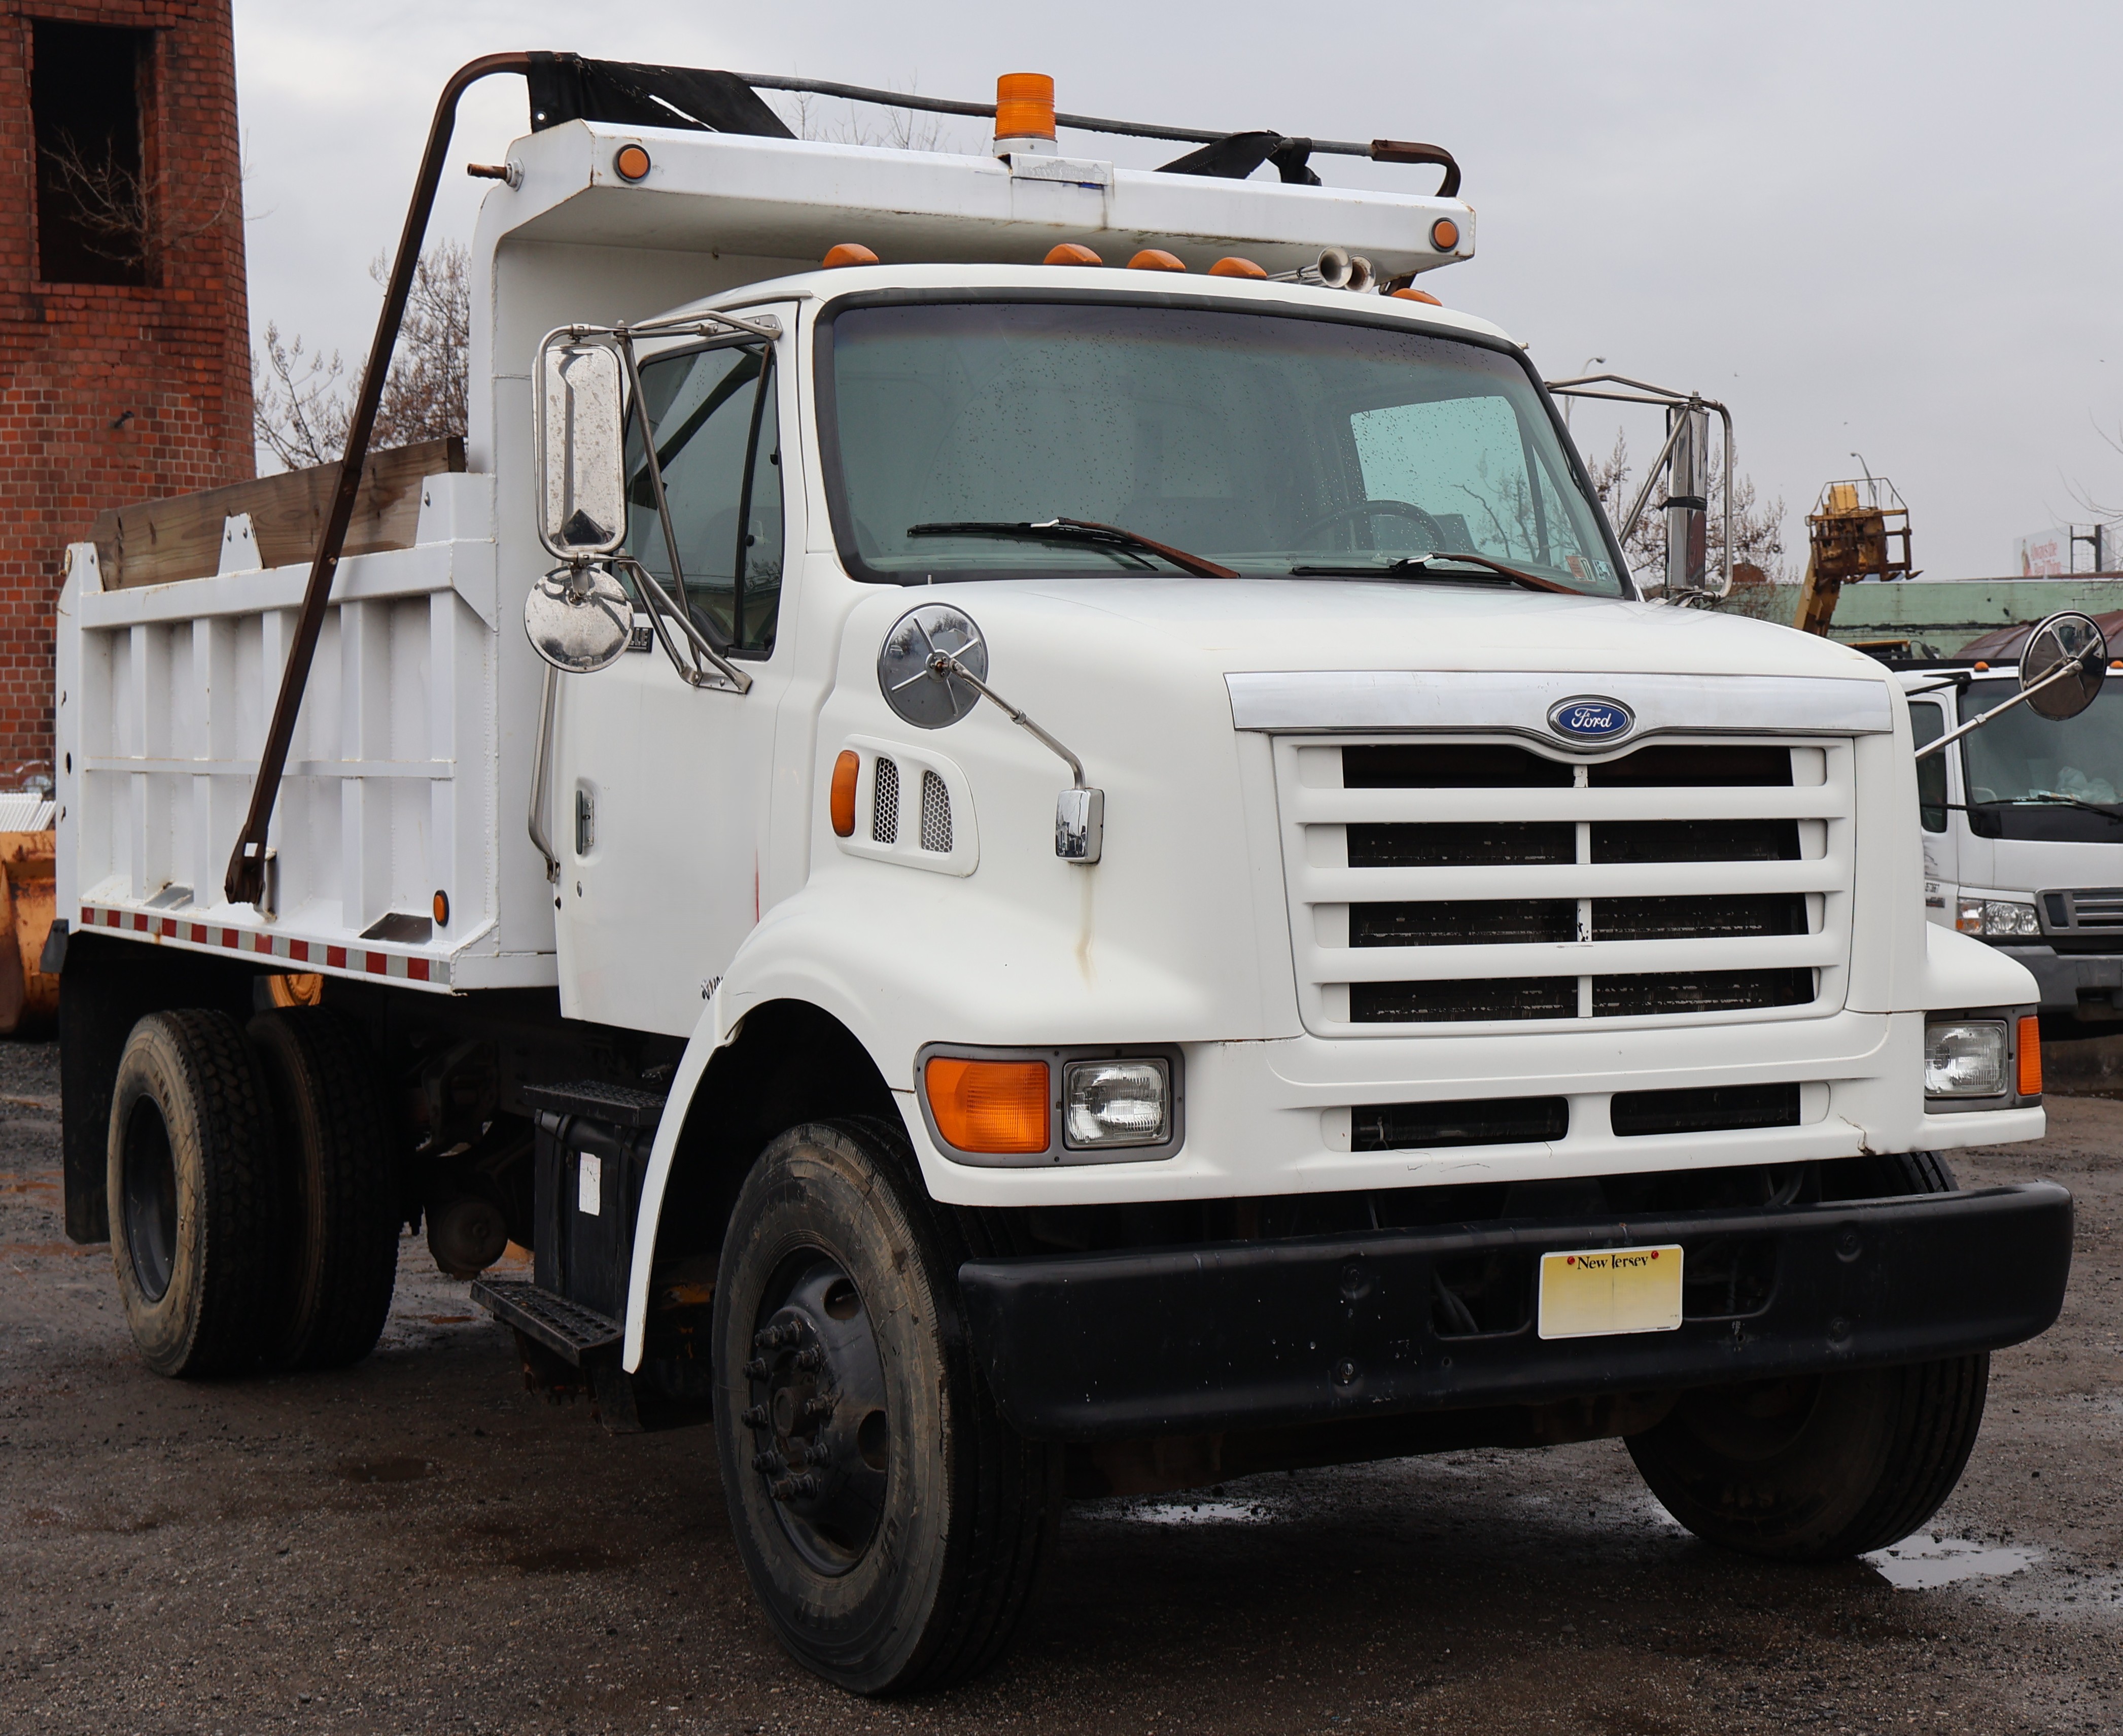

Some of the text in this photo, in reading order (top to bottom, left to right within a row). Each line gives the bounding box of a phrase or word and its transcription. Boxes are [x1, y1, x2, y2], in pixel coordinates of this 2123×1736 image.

[1572, 707, 1613, 728] Ford
[1577, 1254, 1649, 1270] New Jersey
